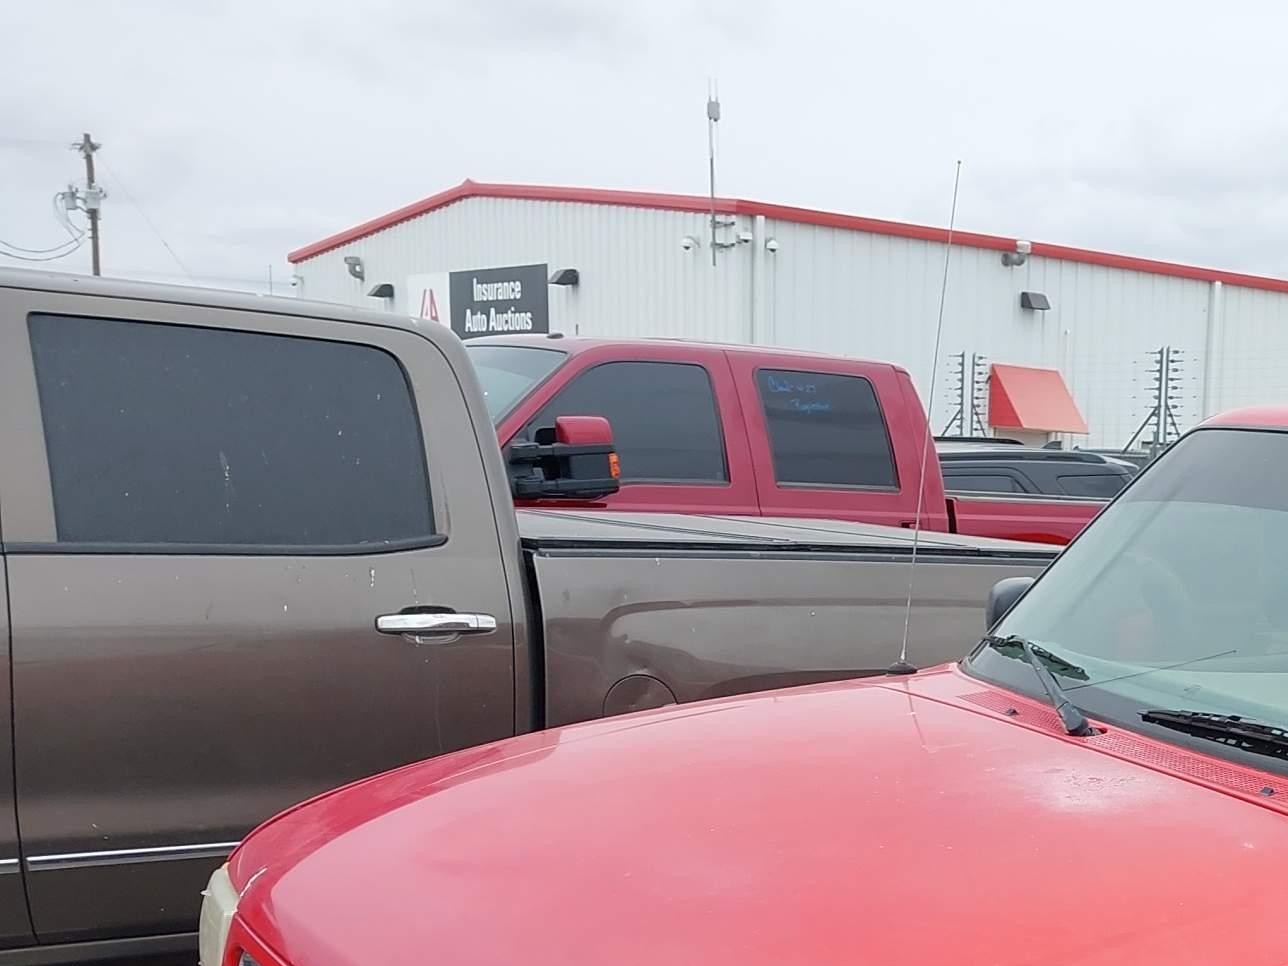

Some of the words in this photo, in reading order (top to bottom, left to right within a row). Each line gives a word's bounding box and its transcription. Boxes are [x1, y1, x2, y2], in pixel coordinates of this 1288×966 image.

[473, 277, 522, 302] Insurance
[464, 308, 488, 333] Auto
[488, 306, 533, 332] Auctions
